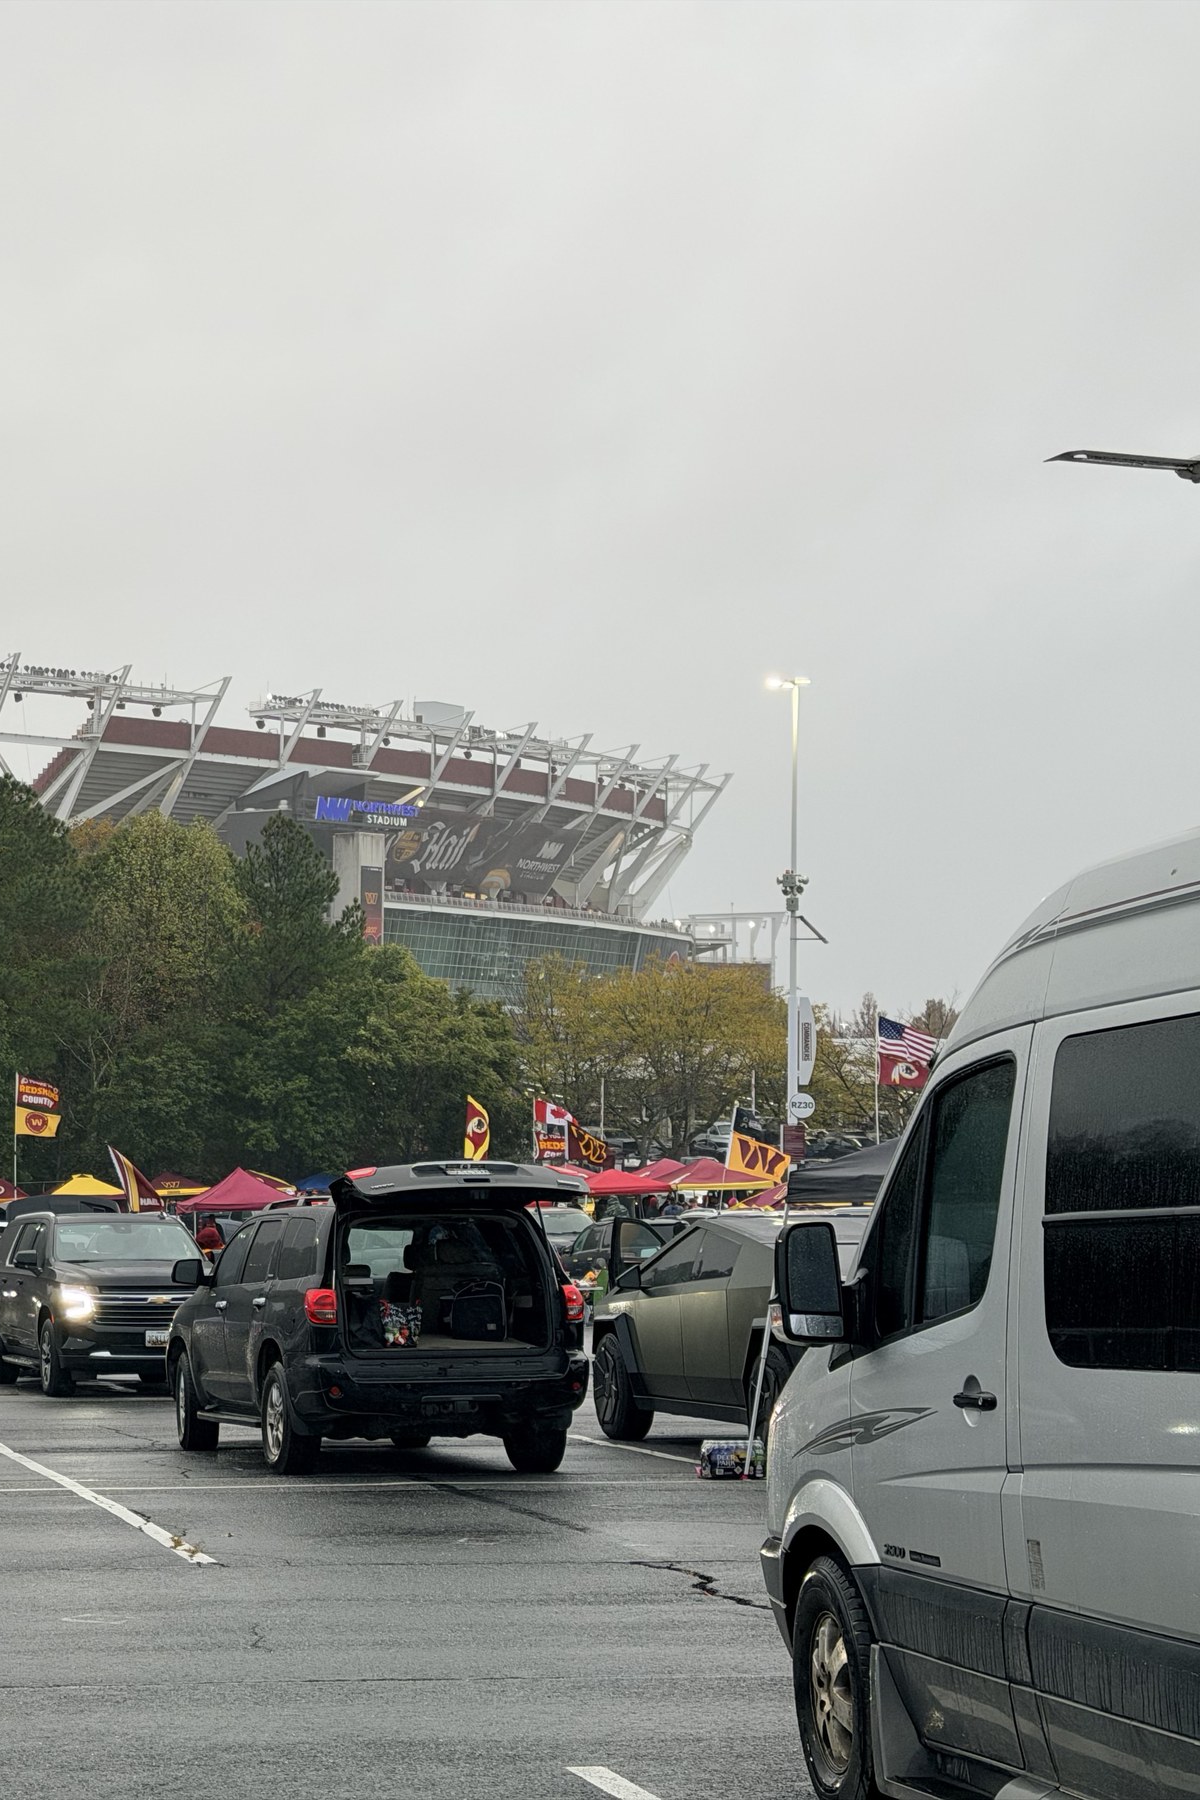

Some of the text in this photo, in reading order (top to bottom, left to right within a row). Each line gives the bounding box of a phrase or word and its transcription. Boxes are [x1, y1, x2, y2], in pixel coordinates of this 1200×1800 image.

[352, 799, 420, 817] NORTHWEST
[367, 814, 407, 826] STADIUM
[516, 858, 561, 873] NORTHWEST
[803, 1022, 812, 1062] COMMANDERS
[791, 1101, 814, 1109] RZ30
